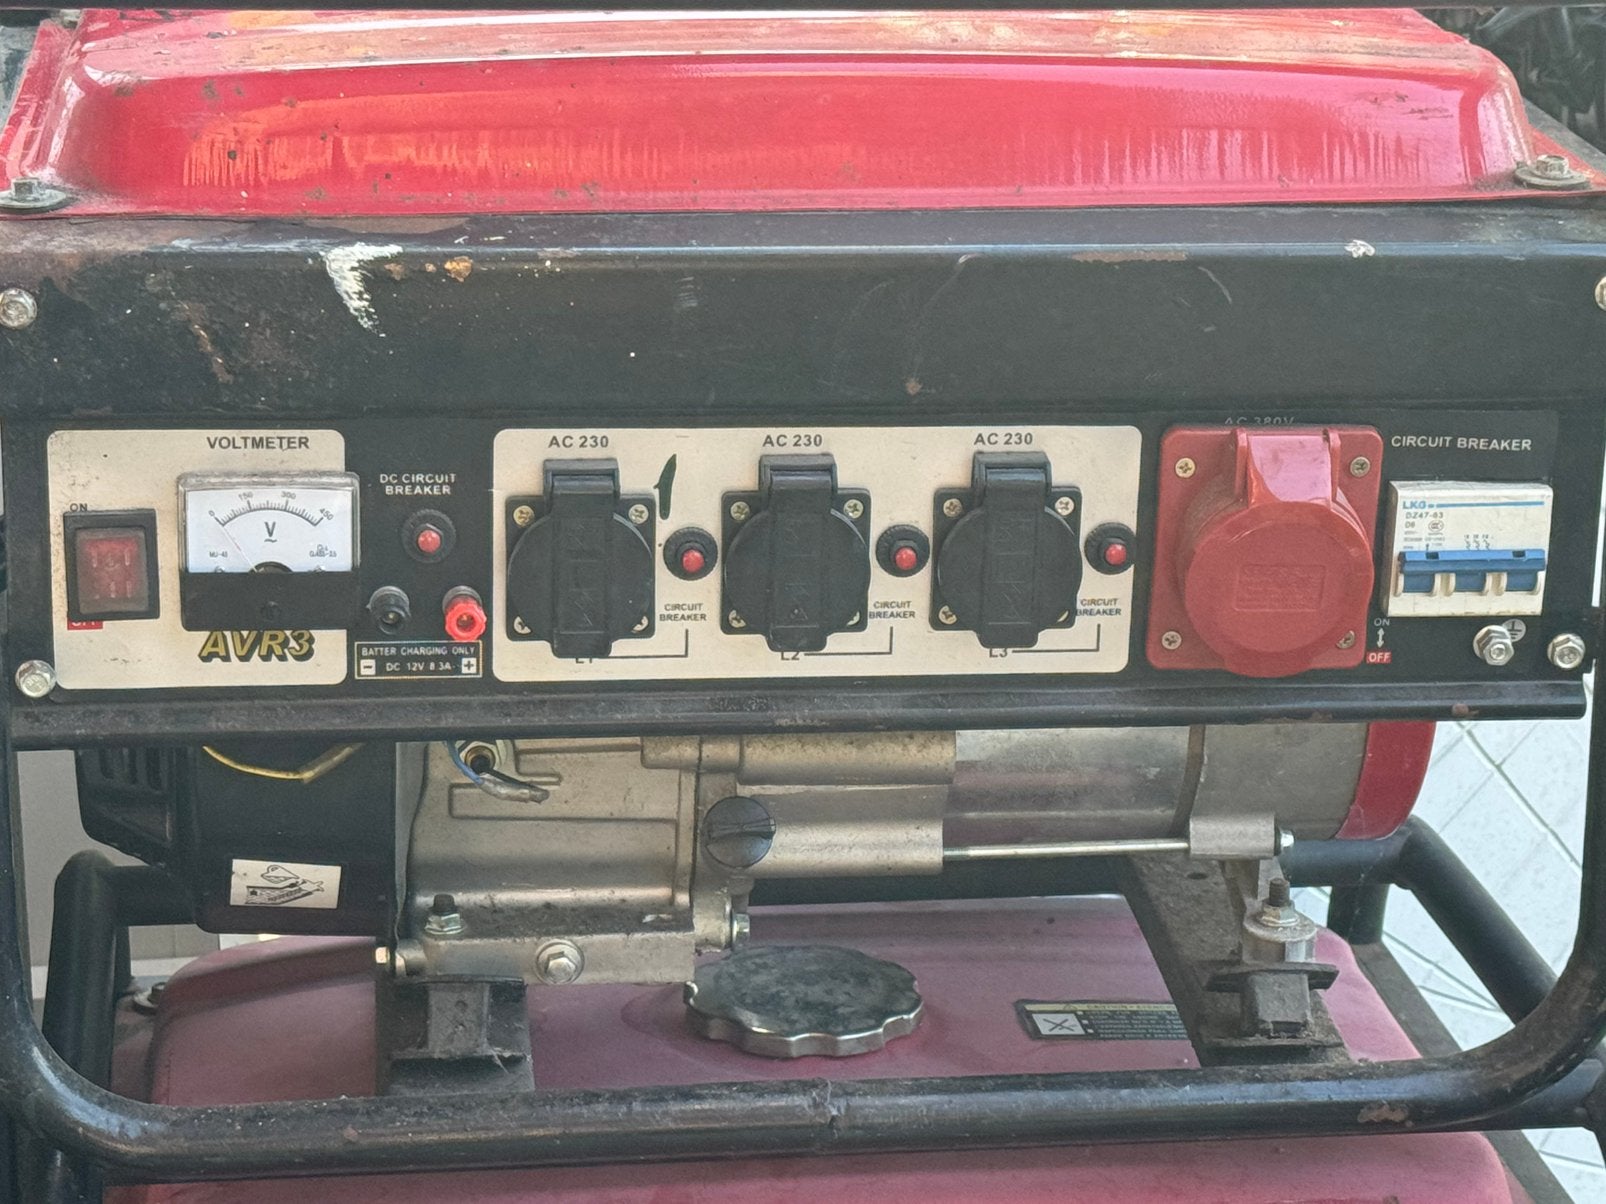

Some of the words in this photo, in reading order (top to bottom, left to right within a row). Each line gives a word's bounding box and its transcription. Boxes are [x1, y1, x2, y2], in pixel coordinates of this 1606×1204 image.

[206, 436, 309, 449] VOLTMETER
[548, 435, 574, 449] AC
[579, 435, 609, 449] 230
[763, 434, 788, 448] AC
[793, 434, 822, 448] 230
[974, 432, 998, 446] AC
[1003, 432, 1033, 446] 230
[1391, 435, 1453, 448] CIRCUIT
[1457, 437, 1532, 451] BREAKER
[380, 473, 398, 484] DC
[402, 473, 457, 484] CIRCUIT
[385, 485, 452, 496] BREAKER
[70, 502, 88, 512] ON
[265, 521, 276, 537] V
[664, 602, 704, 612] CIRCUIT
[873, 600, 912, 609] CIRCUIT
[1080, 597, 1119, 607] CIRCUIT
[659, 613, 707, 622] BREAKER
[868, 610, 916, 620] BREAKER
[1076, 608, 1122, 617] BREAKER
[1373, 617, 1390, 627] ON
[198, 630, 315, 663] AVR3
[361, 647, 396, 656] BATTER
[400, 646, 448, 656] CHARGING
[451, 645, 475, 655] ONLY
[1368, 652, 1392, 663] OFF
[386, 663, 400, 672] DC
[407, 662, 424, 672] 12V
